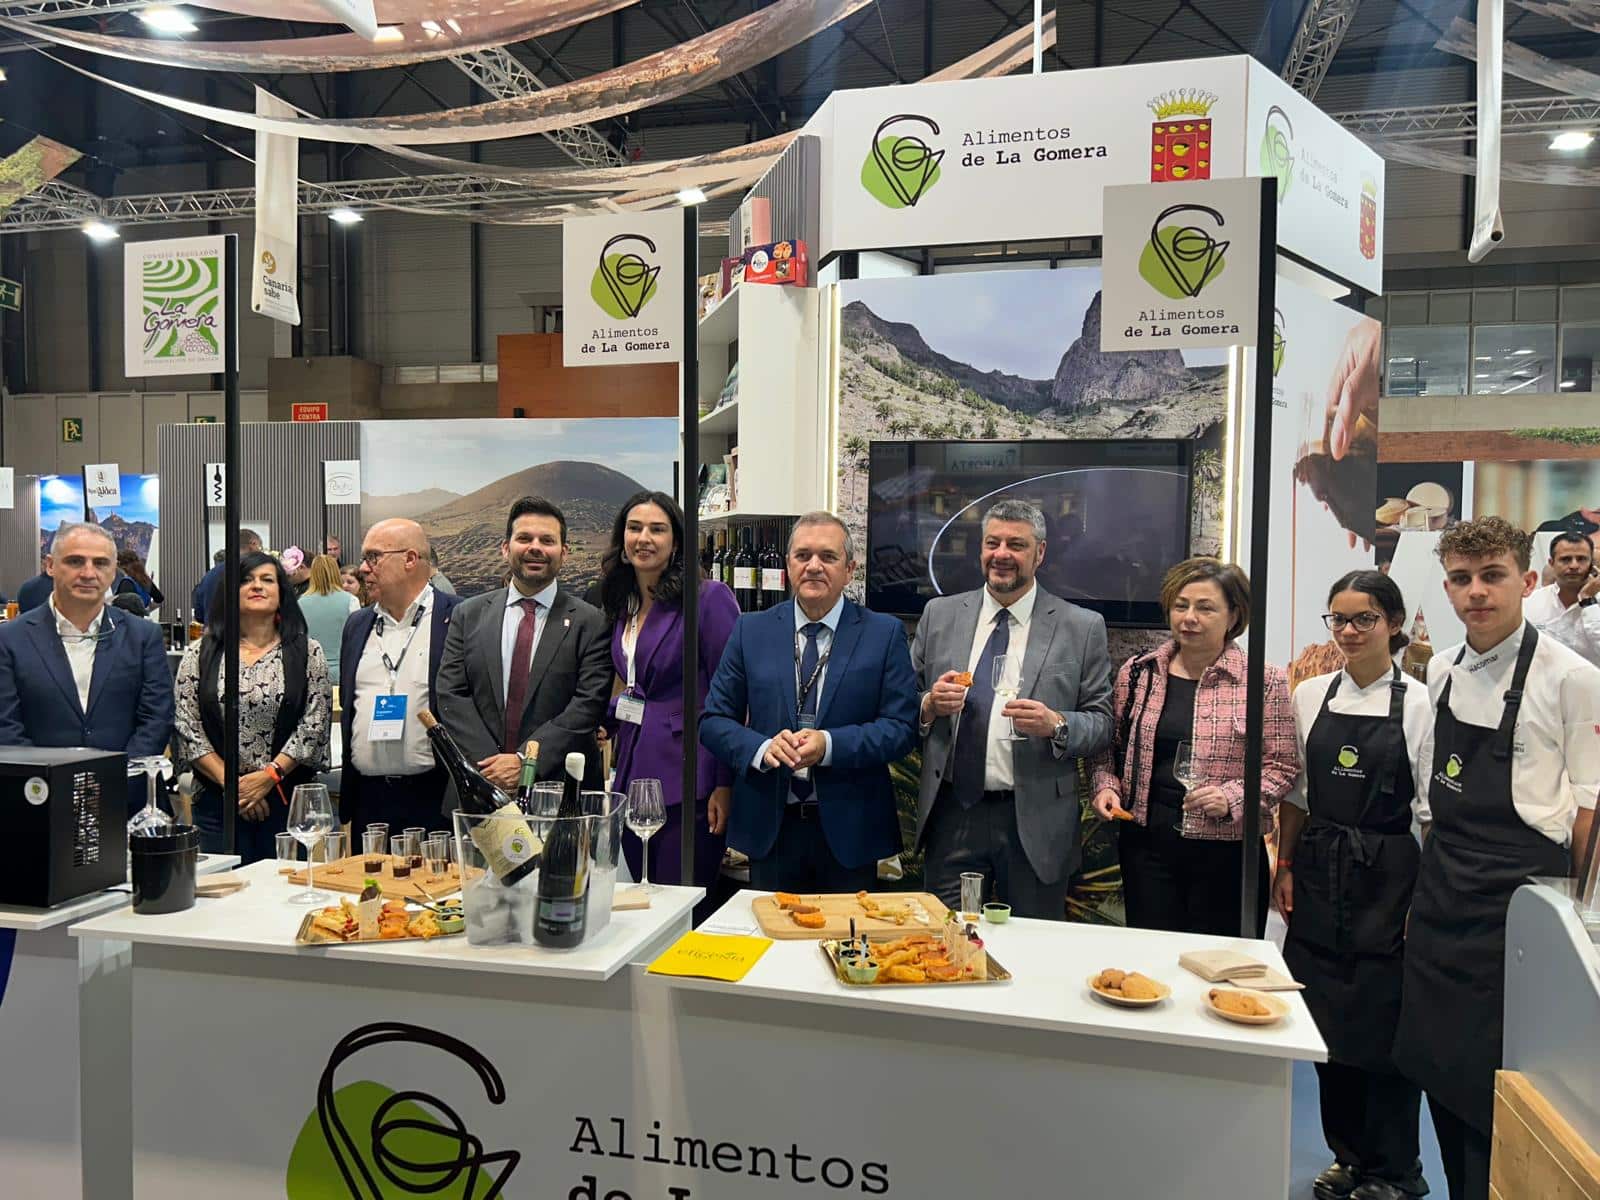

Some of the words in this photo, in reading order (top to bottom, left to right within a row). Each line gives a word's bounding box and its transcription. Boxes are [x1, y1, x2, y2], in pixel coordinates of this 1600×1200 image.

[962, 127, 1071, 146] Alimentos
[962, 153, 985, 167] de
[995, 151, 1021, 165] La
[1034, 145, 1108, 162] Gomera
[160, 297, 187, 316] La
[1138, 309, 1225, 321] Alimentos
[143, 311, 217, 348] Gomera
[592, 328, 658, 339] Alimentos
[1124, 327, 1143, 337] de
[1151, 325, 1171, 336] La
[1181, 324, 1239, 335] Gomera
[581, 344, 596, 353] de
[601, 342, 618, 352] La
[625, 341, 670, 351] Gomera
[569, 1116, 890, 1194] Alimentos
